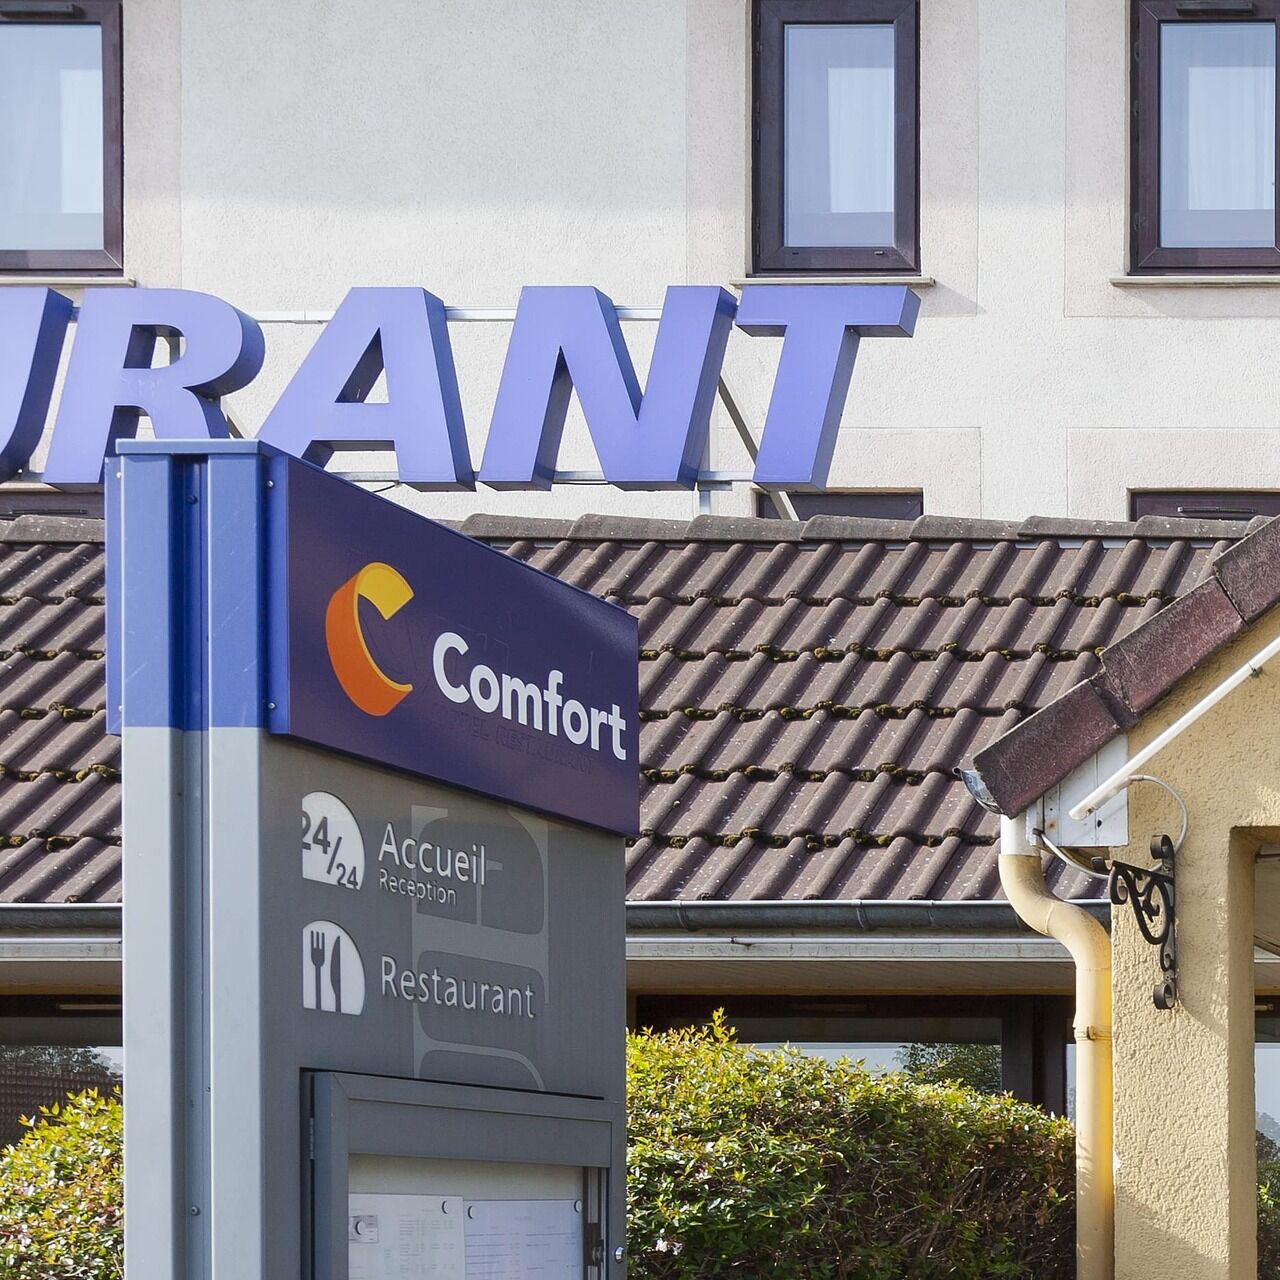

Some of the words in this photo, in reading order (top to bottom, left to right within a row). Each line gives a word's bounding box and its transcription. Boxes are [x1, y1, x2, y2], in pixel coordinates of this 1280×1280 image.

[433, 631, 627, 761] Comfort
[378, 822, 487, 886] Accueil
[379, 868, 457, 906] Reception
[381, 954, 537, 1019] Restaurant
